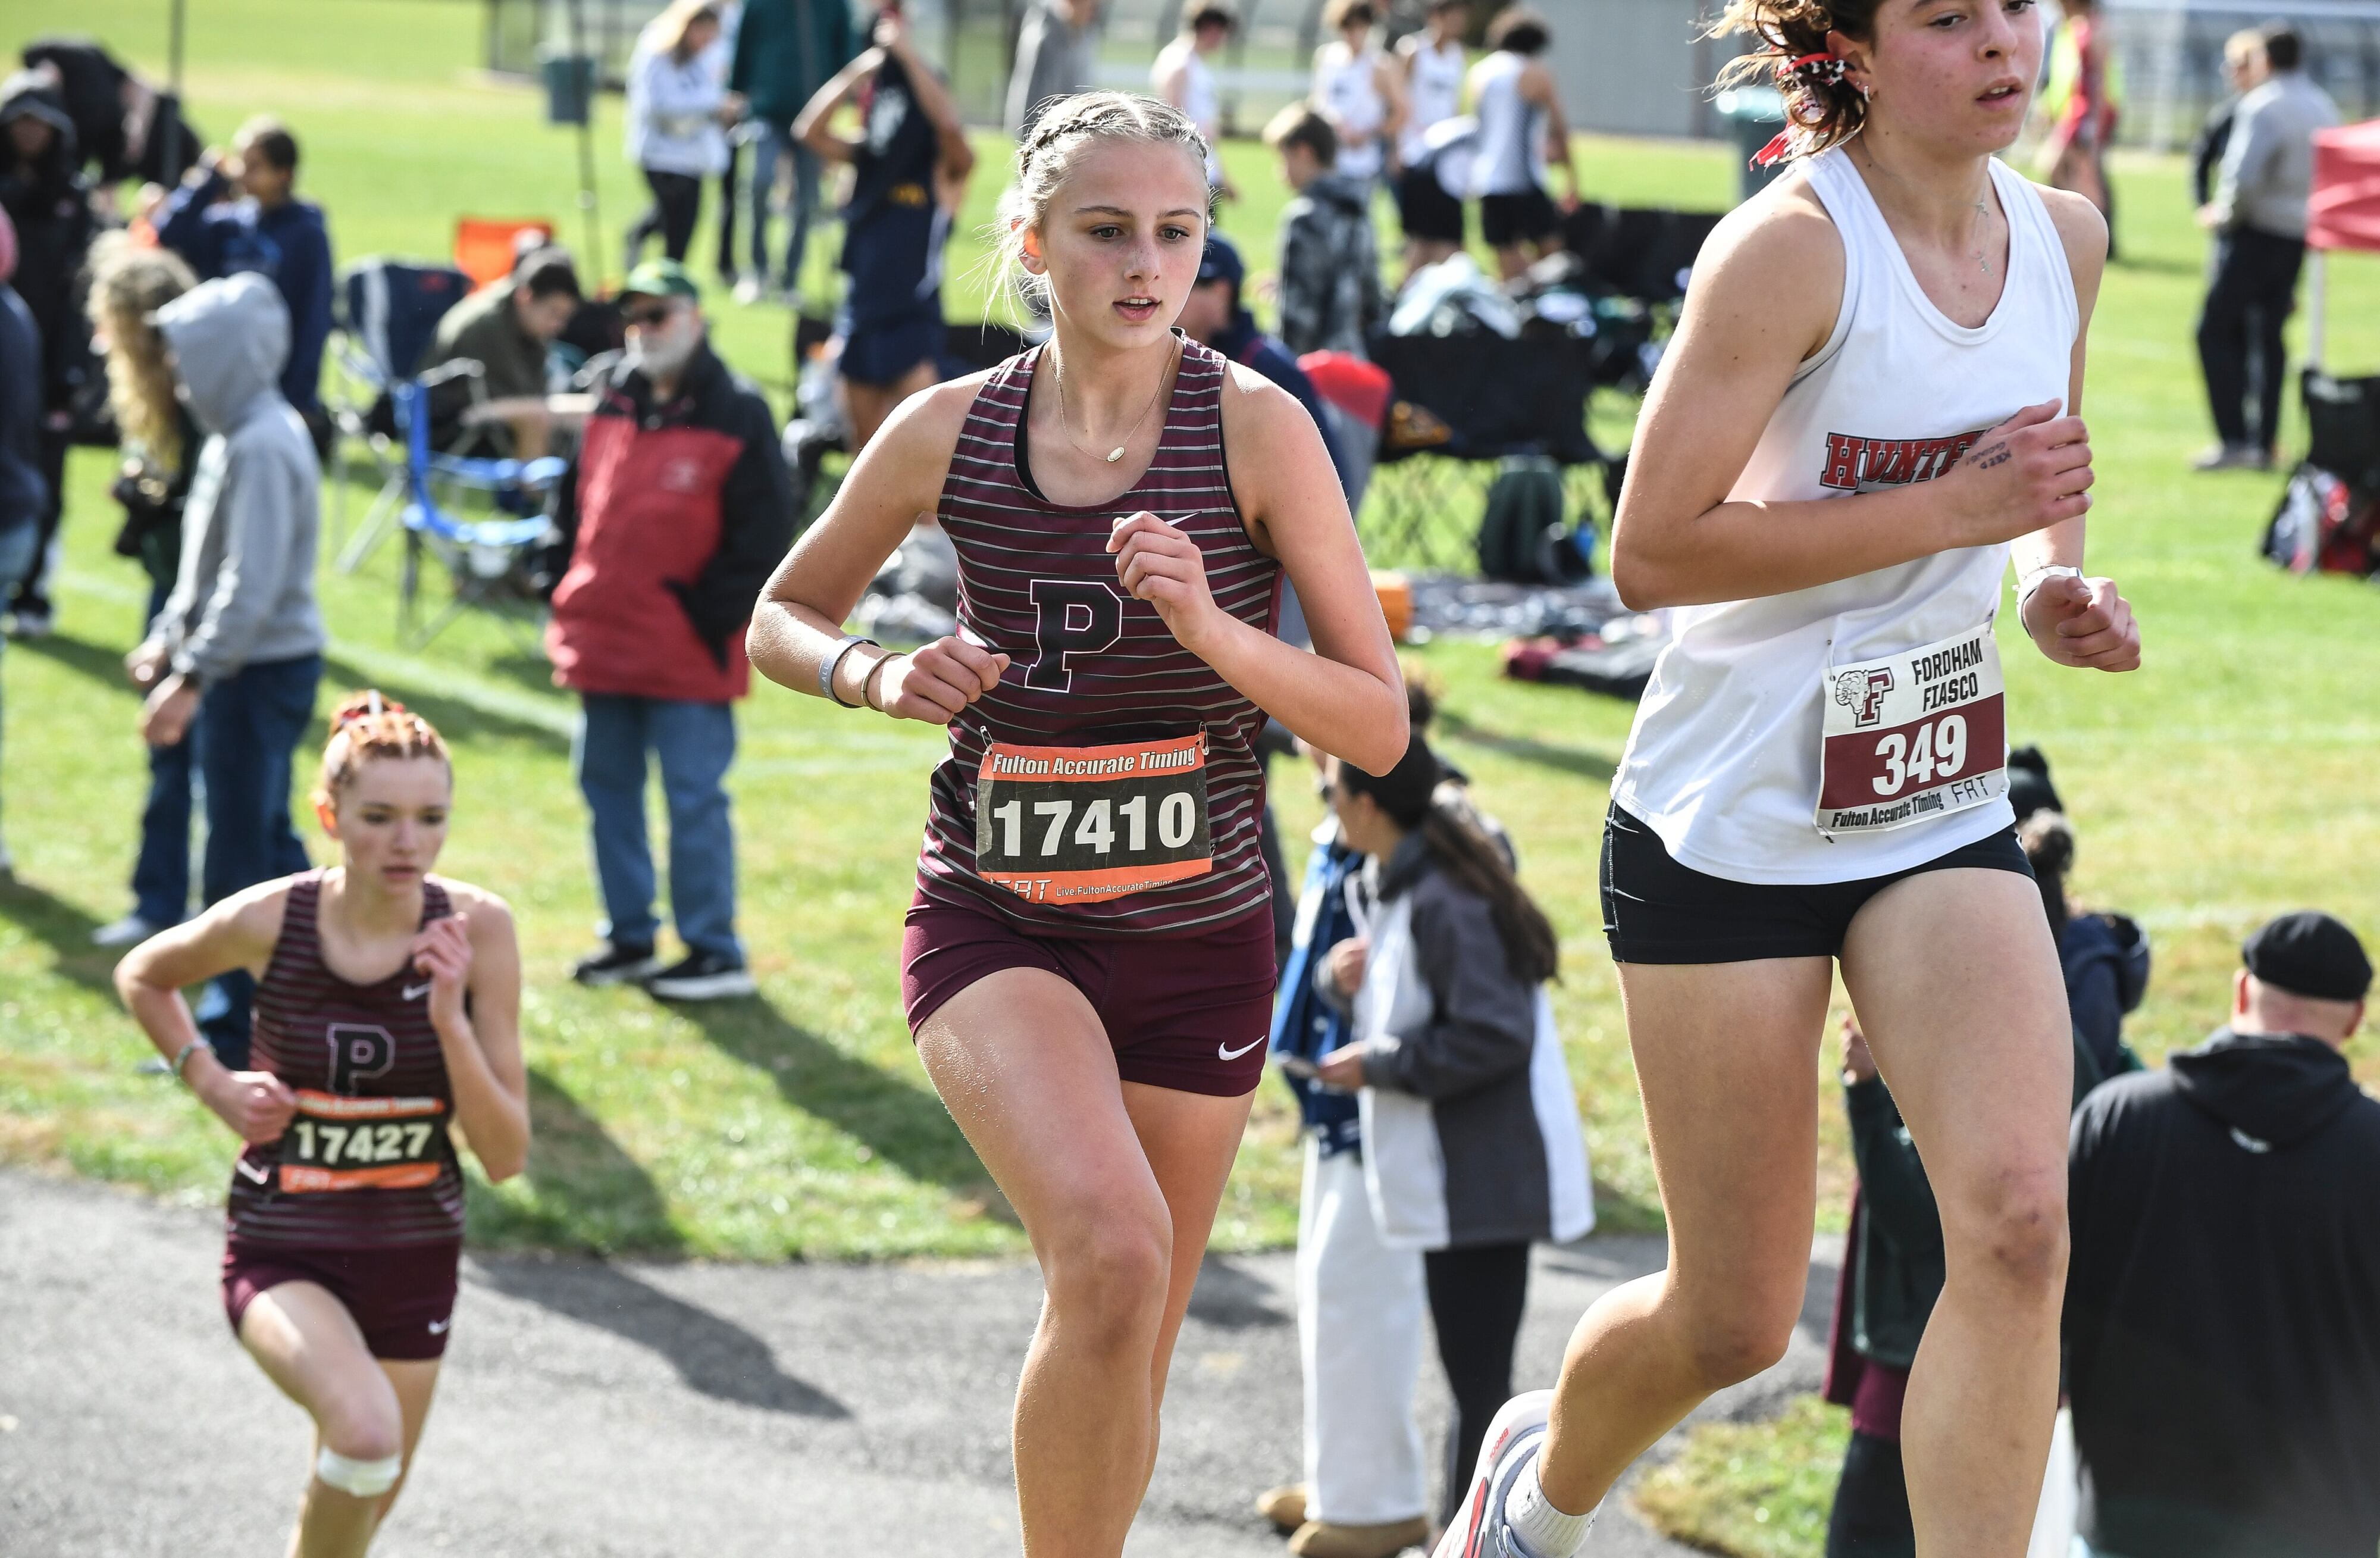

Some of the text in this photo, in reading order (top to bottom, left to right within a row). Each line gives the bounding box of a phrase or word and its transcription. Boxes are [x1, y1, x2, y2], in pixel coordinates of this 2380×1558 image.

[1819, 429, 1986, 490] HUNTE
[1025, 579, 1122, 693] P
[1911, 637, 1983, 685] FORDHAM
[1922, 672, 1978, 712] FIASCO
[992, 746, 1196, 775] Fulton Accurate Timing
[1872, 714, 1967, 796] 349
[993, 791, 1196, 857] 17410
[1831, 775, 1990, 828] Fulton Accurate Timing FAT
[326, 1022, 396, 1096] P
[293, 1121, 433, 1165] 17427
